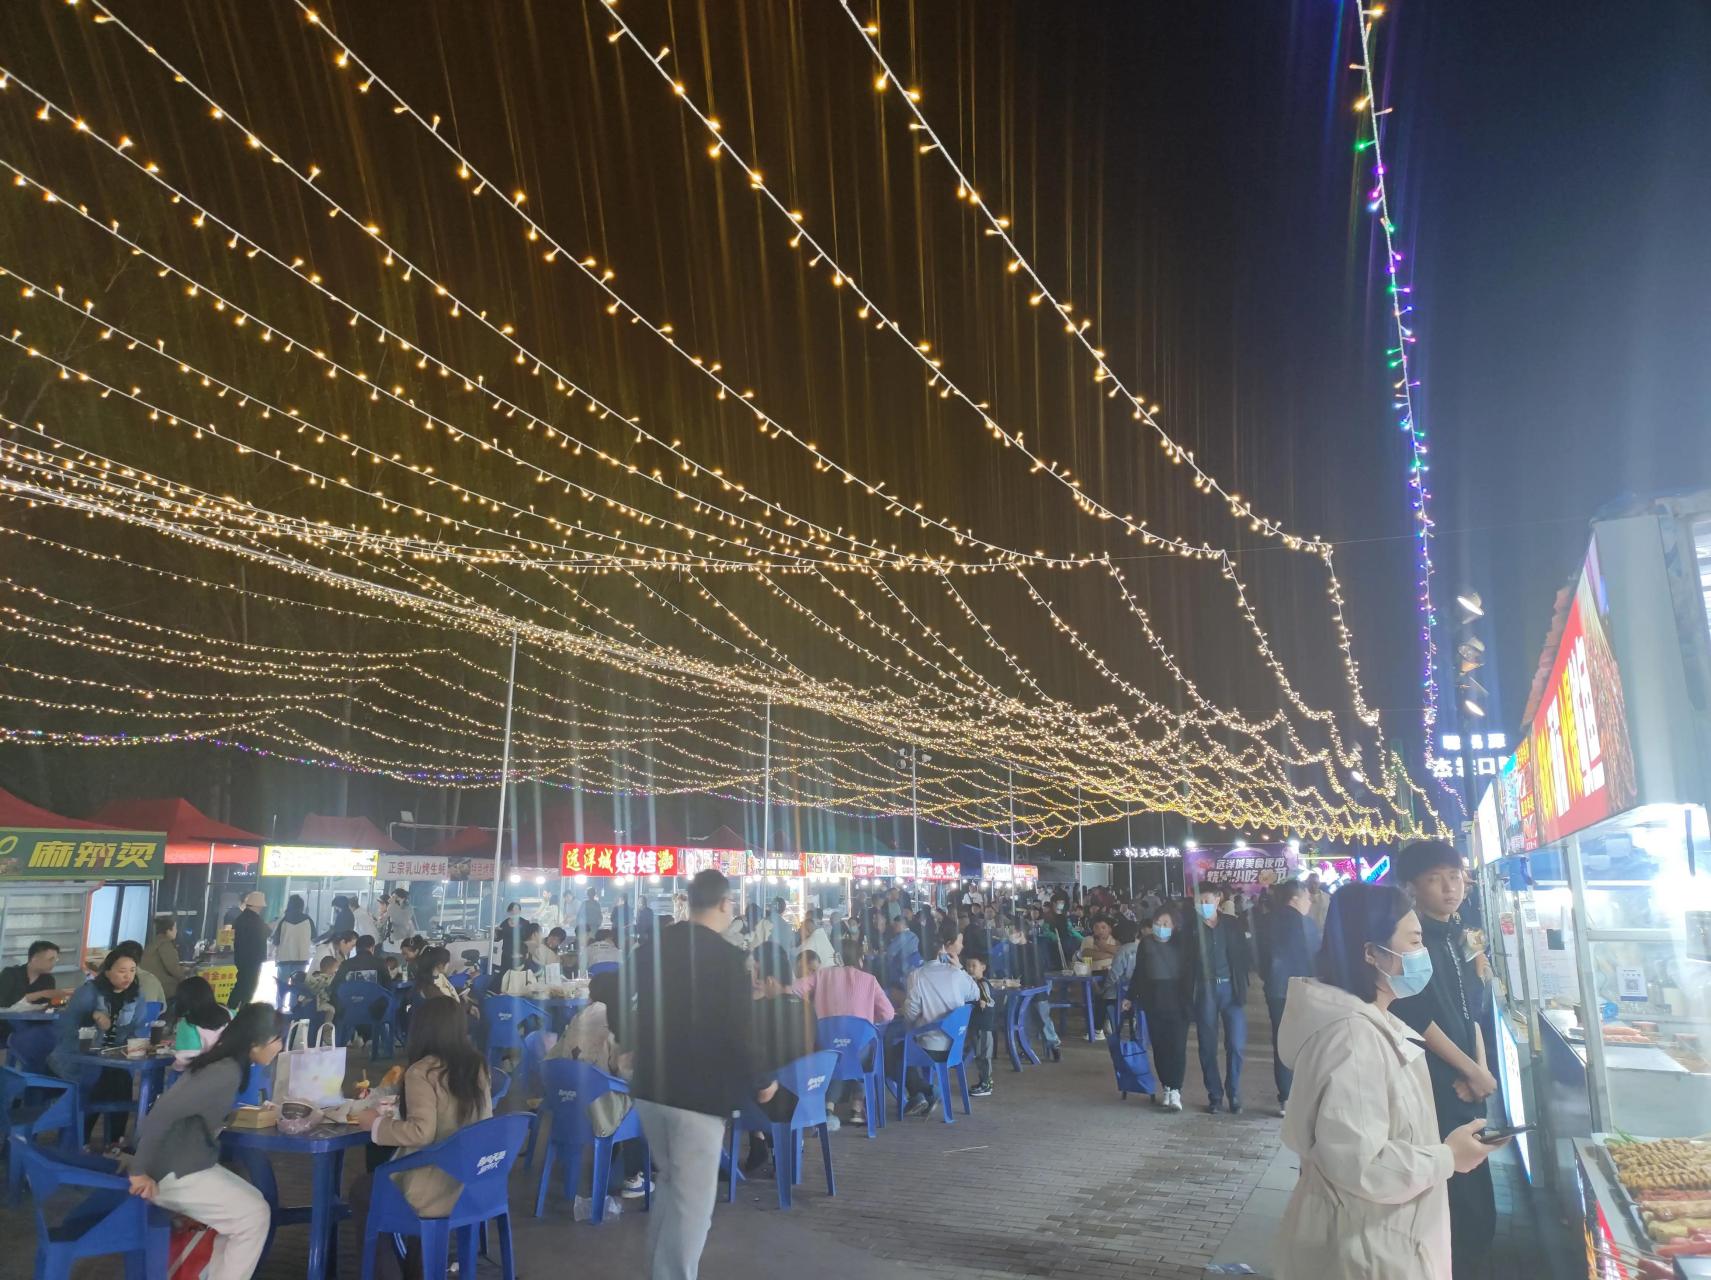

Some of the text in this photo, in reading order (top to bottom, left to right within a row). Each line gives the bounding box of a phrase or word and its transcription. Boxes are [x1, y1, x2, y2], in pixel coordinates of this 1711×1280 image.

[28, 840, 157, 868] 麻辣烫
[1216, 857, 1285, 869] 远洋城美食夜市
